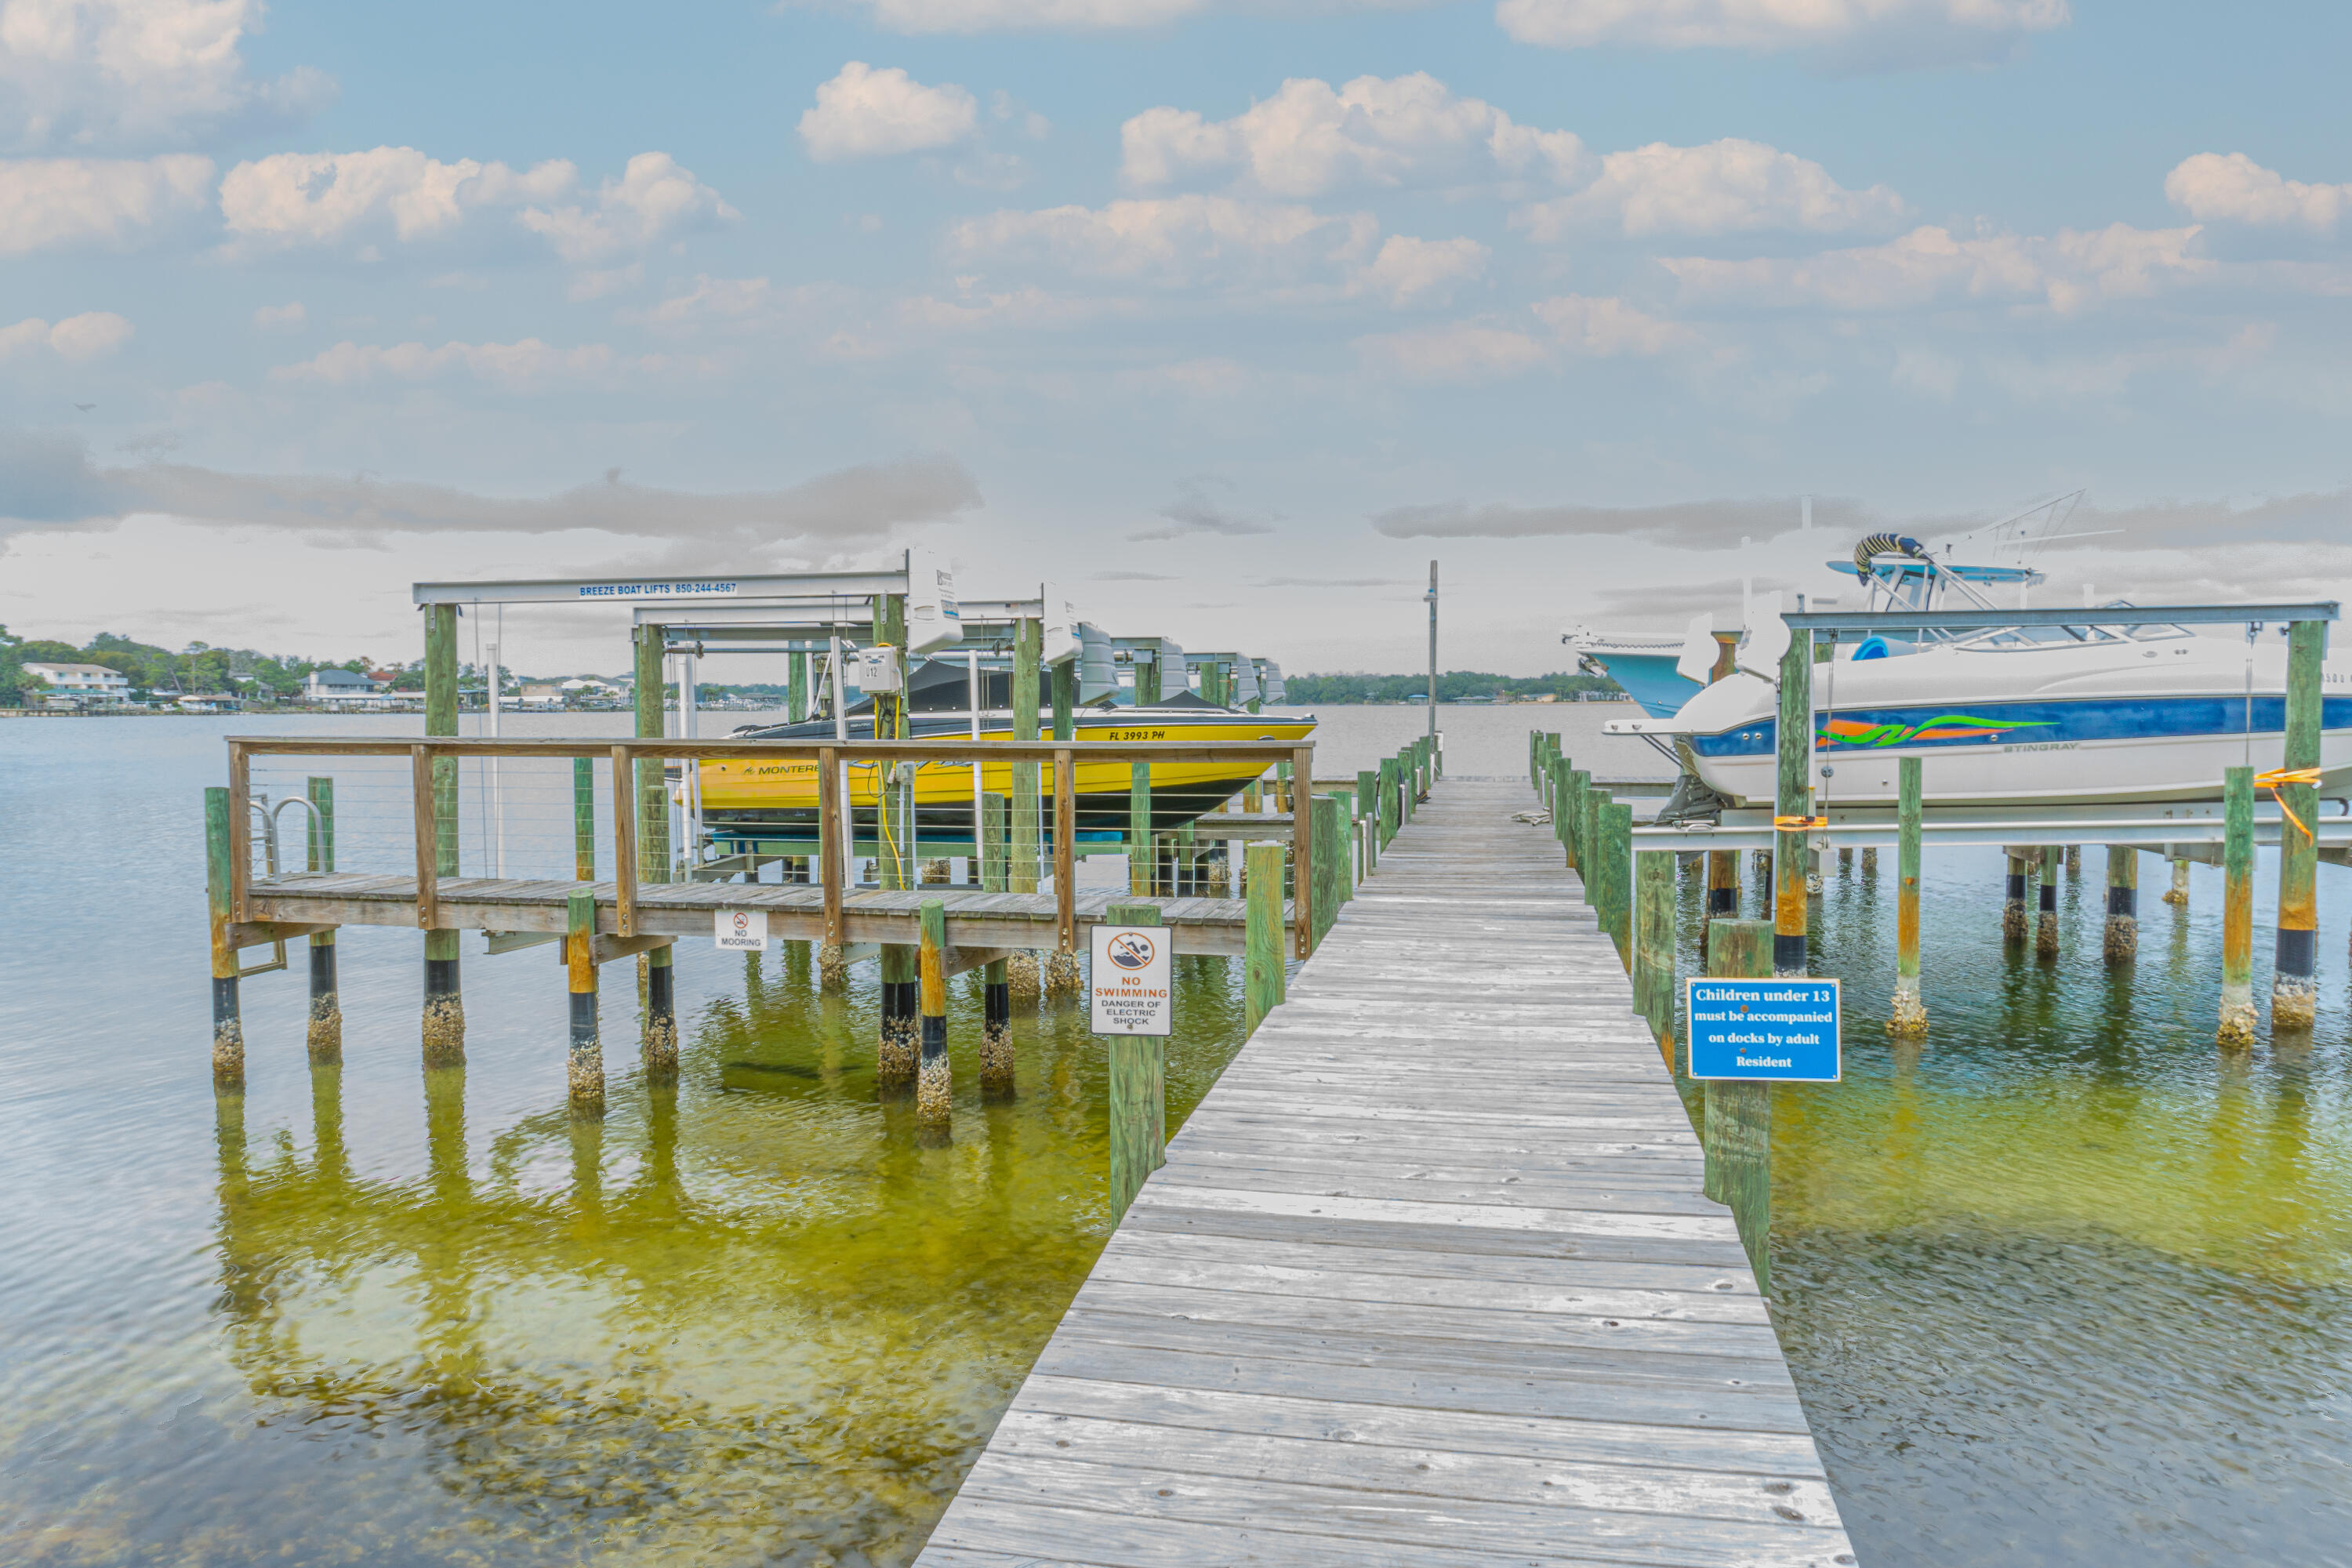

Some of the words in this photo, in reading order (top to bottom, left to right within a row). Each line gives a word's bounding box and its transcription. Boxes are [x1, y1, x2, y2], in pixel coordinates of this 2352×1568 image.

[580, 586, 615, 596] BREEZE
[618, 585, 641, 594] BOAT
[644, 584, 670, 594] LIFTS
[676, 583, 736, 593] 850-244-4567
[1109, 731, 1120, 740] FL
[1123, 731, 1149, 740] 3993
[1152, 731, 1165, 739] PH
[2004, 742, 2078, 753] STINGRAY
[758, 764, 819, 775] MONTERE
[721, 938, 761, 947] MOORING
[1122, 977, 1141, 985] NO
[1095, 988, 1167, 998] SWIMMING
[1695, 989, 1760, 1002] Children
[1764, 989, 1809, 1002] under
[1812, 990, 1831, 1003] 13
[1102, 1000, 1144, 1008] DANGER
[1106, 1008, 1156, 1017] ELECTRIC
[1694, 1011, 1726, 1022] must
[1729, 1011, 1744, 1022] be
[1747, 1011, 1833, 1025] accompanied
[1708, 1034, 1725, 1044] on
[1727, 1032, 1765, 1044] docks
[1767, 1033, 1784, 1047] by
[1786, 1033, 1820, 1045] adult
[1736, 1056, 1792, 1068] Resident
